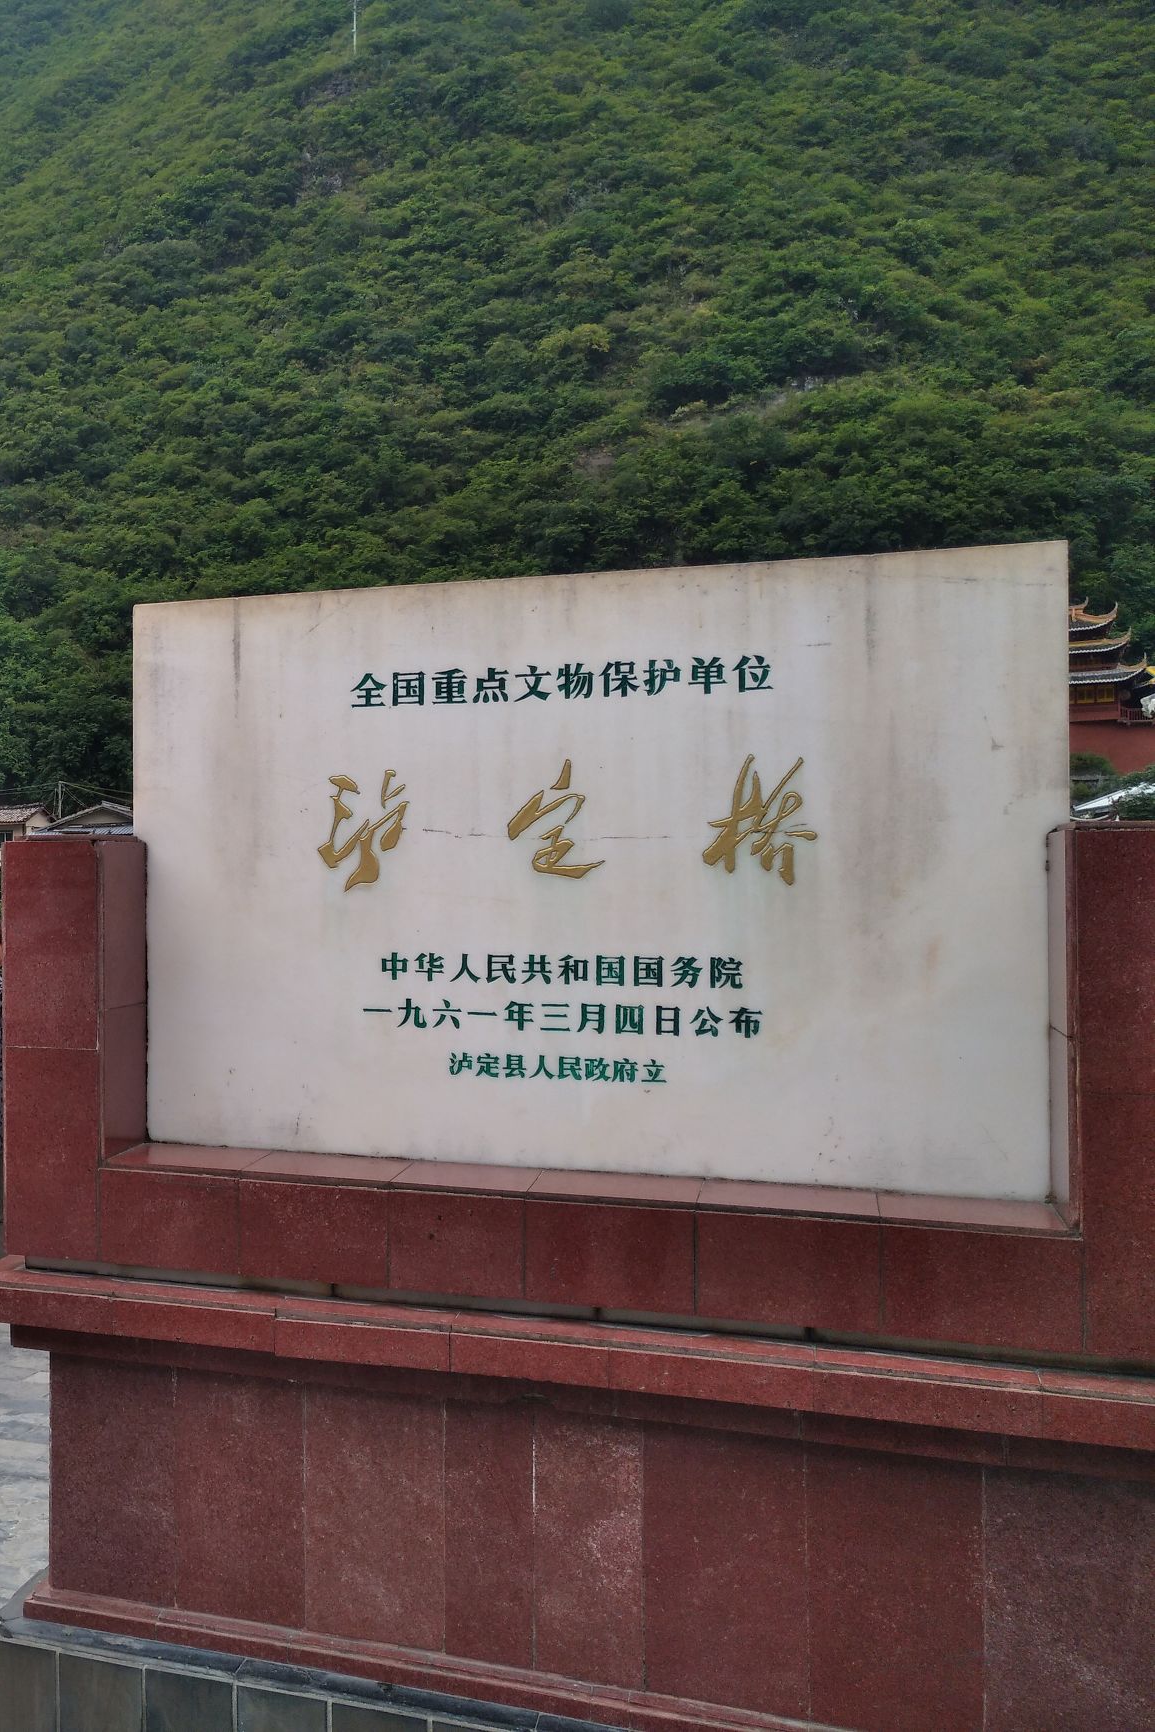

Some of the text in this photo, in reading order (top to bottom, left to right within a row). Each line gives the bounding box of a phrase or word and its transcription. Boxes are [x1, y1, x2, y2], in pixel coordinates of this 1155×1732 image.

[350, 654, 774, 709] 全国重点文物保护单位
[380, 951, 744, 990] 中华人民共和国国务院
[362, 997, 763, 1039] 一九六一年三月四日公布
[448, 1051, 667, 1084] 泸定县人民政府立
